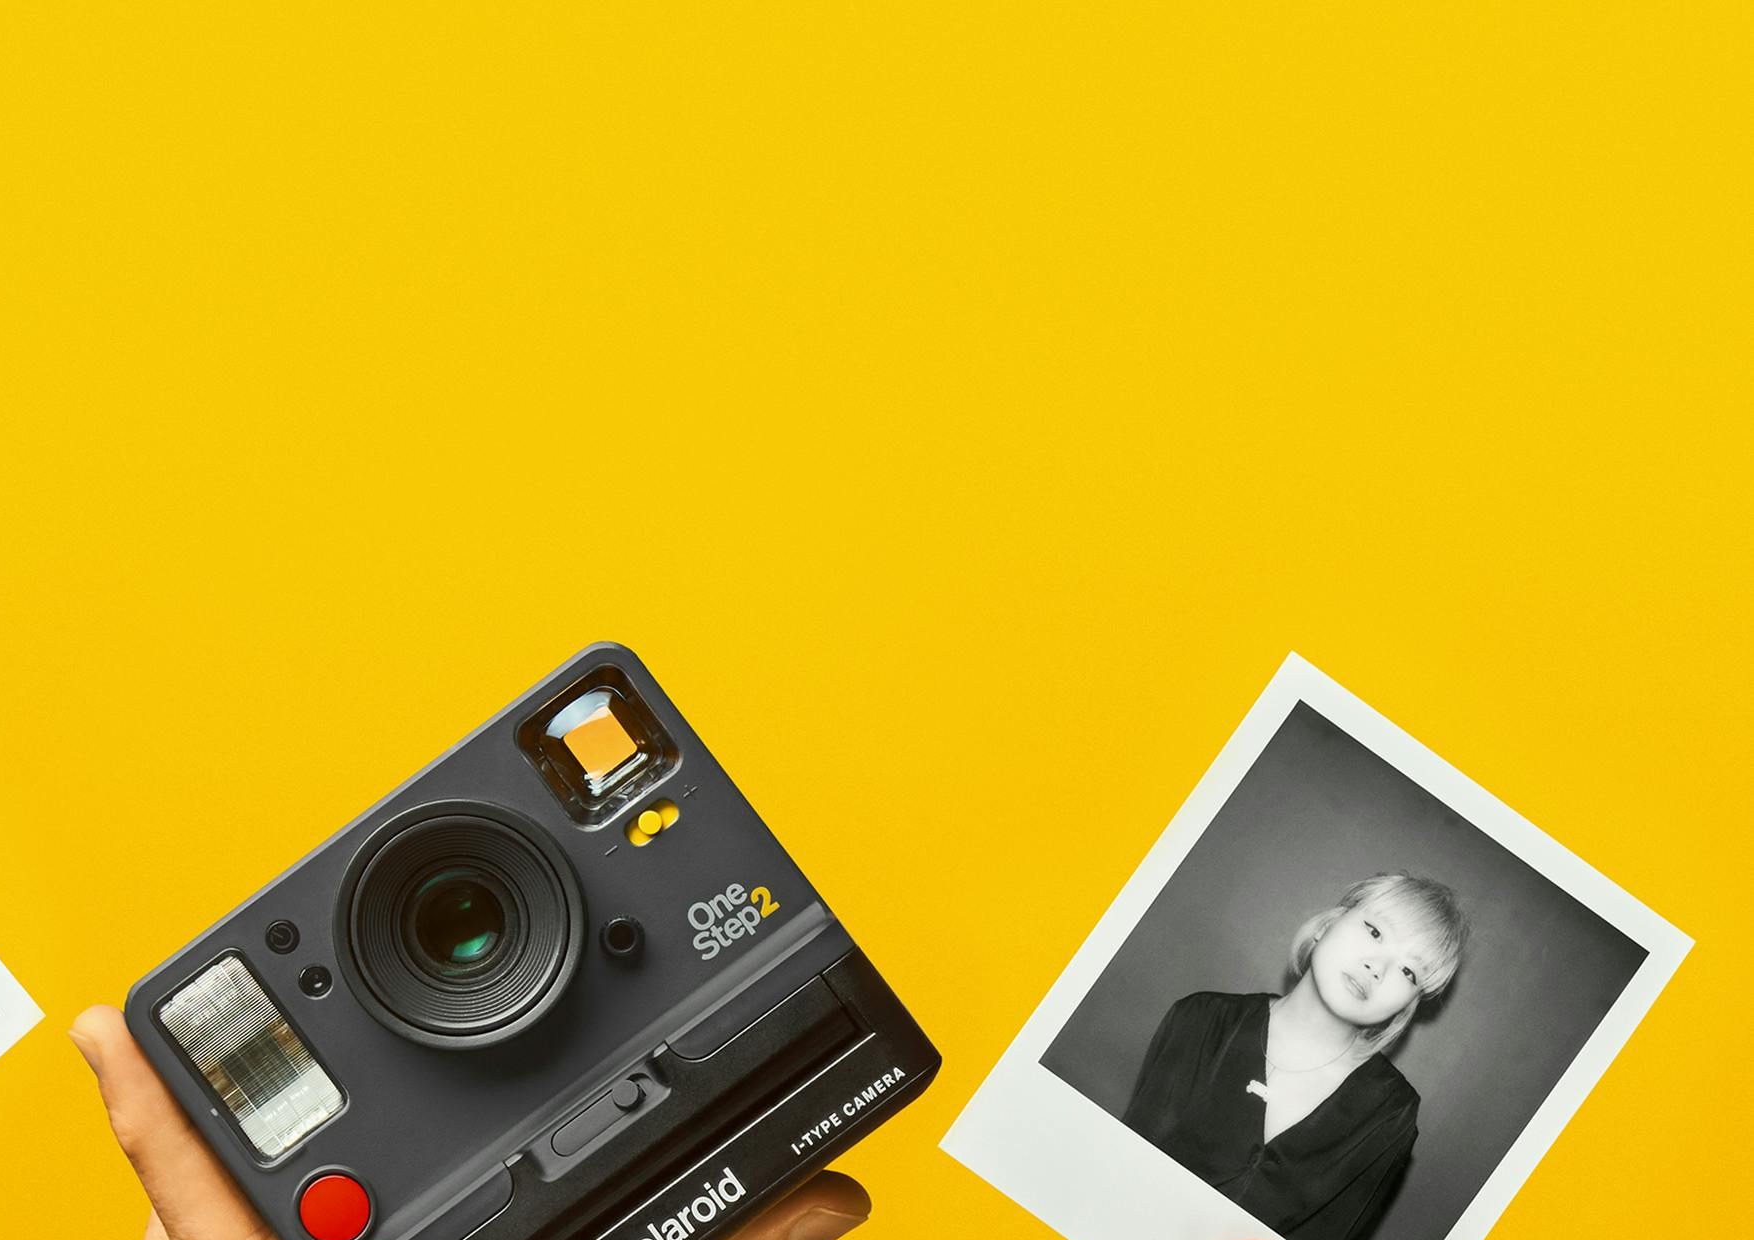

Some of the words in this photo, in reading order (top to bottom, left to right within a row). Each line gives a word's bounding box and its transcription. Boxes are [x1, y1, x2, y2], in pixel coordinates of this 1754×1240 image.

[687, 883, 747, 931] One
[790, 1112, 842, 1155] I-TYPE
[842, 1066, 906, 1117] CAMERA
